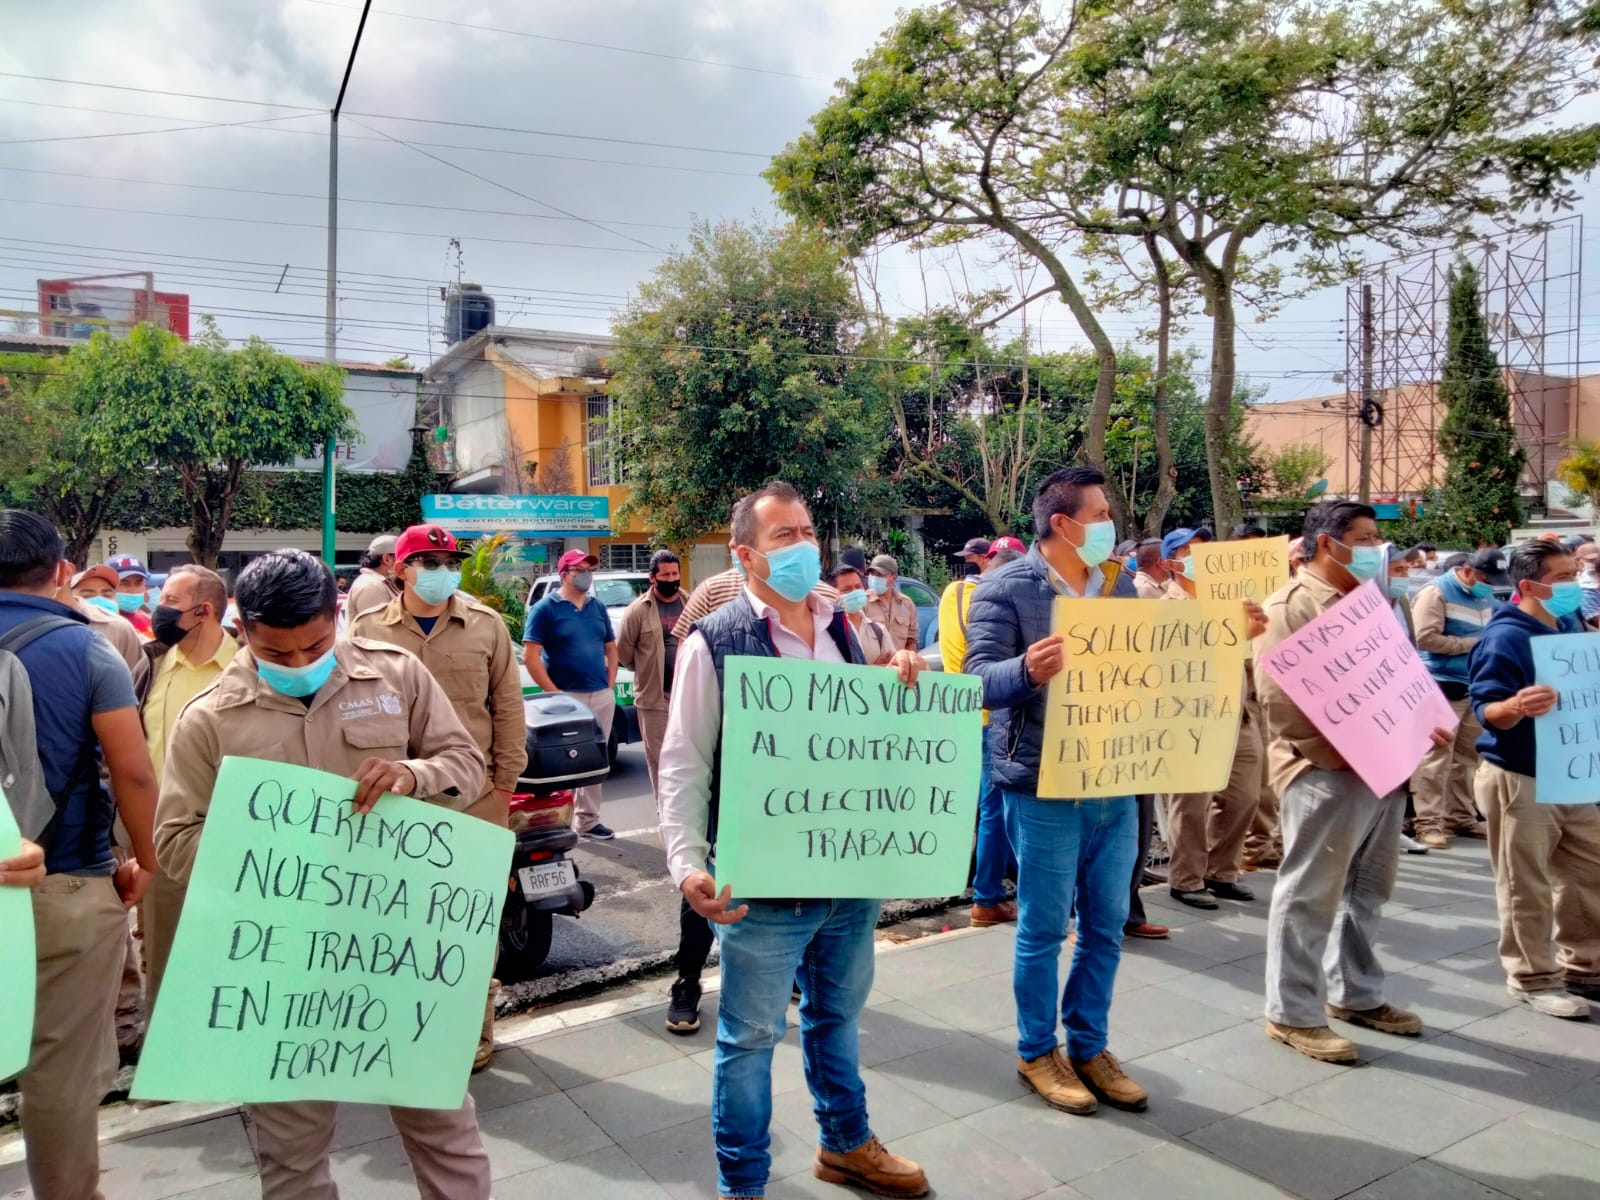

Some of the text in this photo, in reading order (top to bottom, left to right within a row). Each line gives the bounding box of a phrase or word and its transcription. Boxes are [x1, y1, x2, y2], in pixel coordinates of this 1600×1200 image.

[434, 494, 594, 511] Betterware
[1205, 550, 1279, 574] QUEREMOS
[1069, 617, 1238, 657] SOLICITAMOS
[1270, 648, 1299, 676] NO
[1298, 620, 1344, 655] MAS
[1065, 660, 1217, 695] EL PAGO DEL
[1300, 622, 1393, 697] A NUESTRO
[739, 671, 984, 716] NO MAS VIOLACIONES
[1322, 657, 1397, 726] CONTRATO
[1061, 695, 1235, 726] TIEMPO EXTRA
[1370, 706, 1400, 736] DE
[752, 730, 958, 764] AL CONTRATO
[1058, 727, 1204, 764] EN TIEMPO Y
[1559, 722, 1590, 745] DE
[1078, 756, 1172, 792] FORMA
[763, 785, 959, 816] COLECTIVO DE
[247, 779, 454, 868] QUEREMOS
[797, 827, 938, 862] TRABAJO
[234, 848, 497, 936] NUESTRA ROPA
[529, 870, 567, 890] RRF5G
[228, 920, 466, 987] DE TRABAJO
[208, 981, 438, 1042] EN TIEMPO Y
[269, 1037, 394, 1081] FORMA
